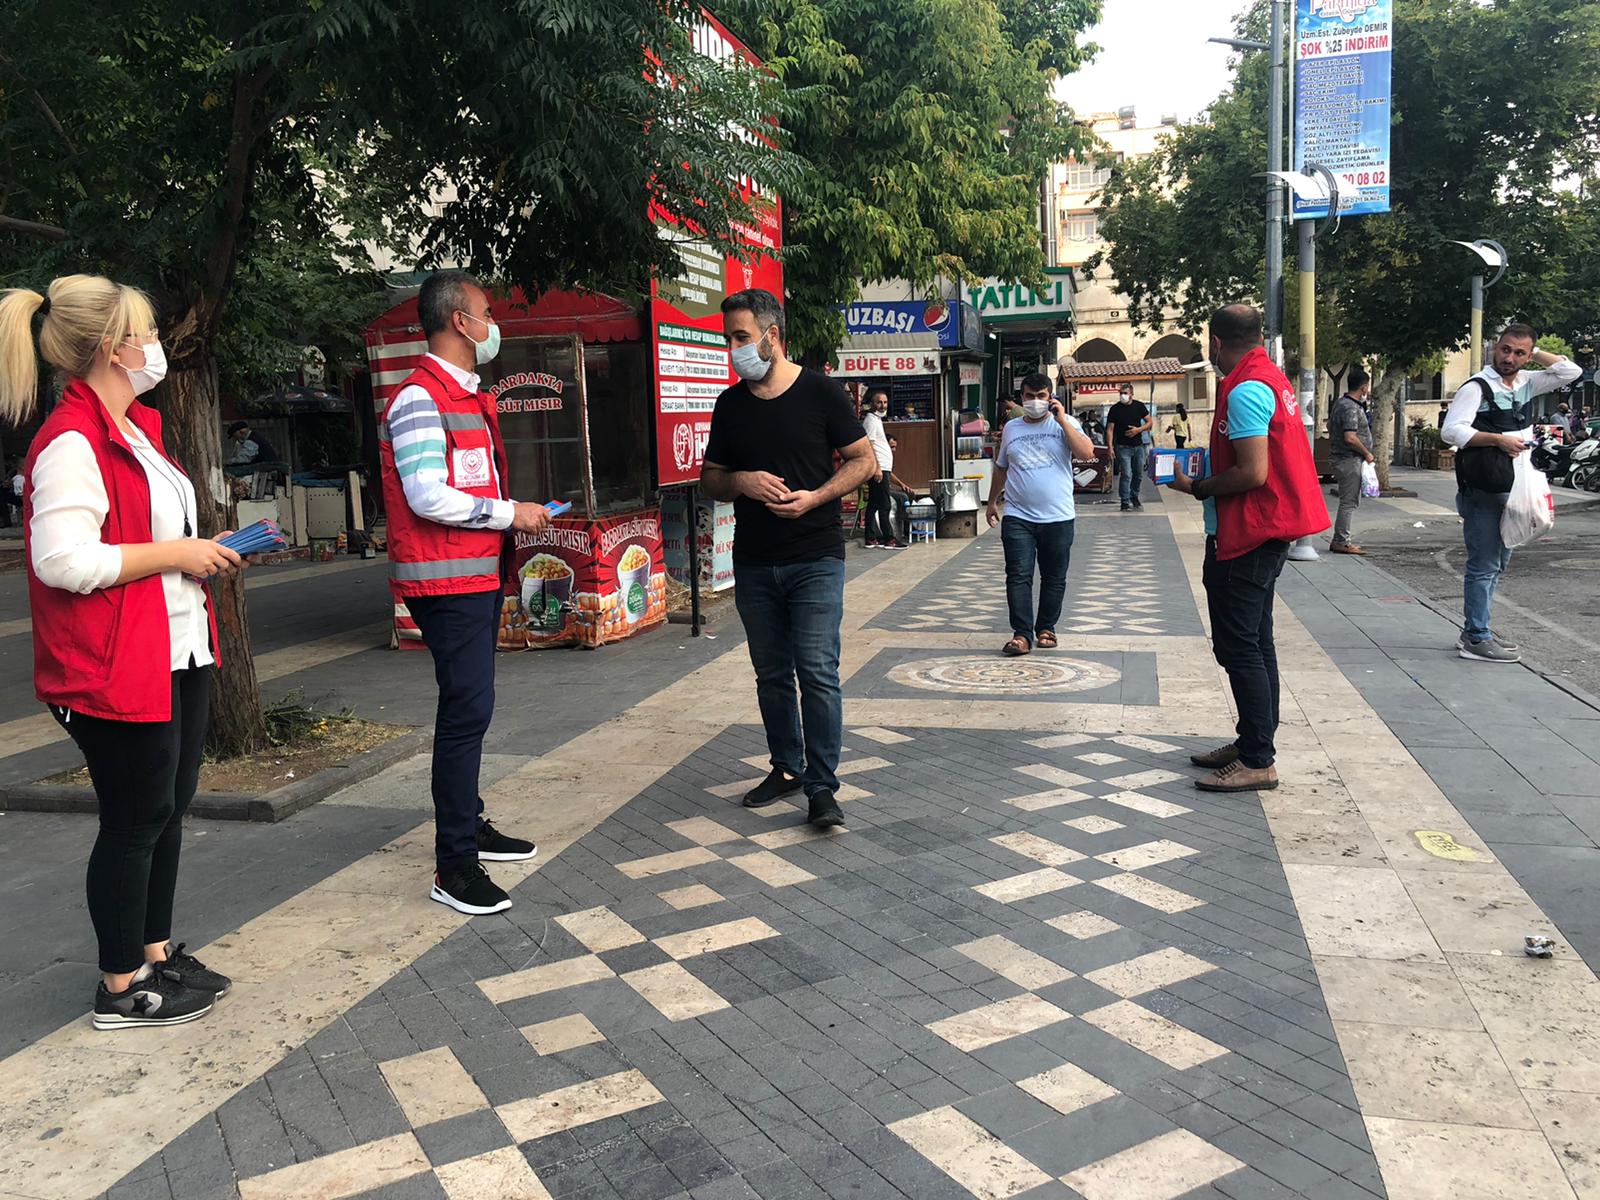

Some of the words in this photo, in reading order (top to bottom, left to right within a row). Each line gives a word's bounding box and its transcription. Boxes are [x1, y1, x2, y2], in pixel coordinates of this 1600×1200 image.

[1333, 25, 1362, 36] Zübeyde
[1300, 42, 1322, 58] ŞOK
[1325, 40, 1342, 54] %25
[1357, 172, 1369, 185] 08
[1372, 171, 1385, 184] 02
[841, 307, 915, 333] UZBAŞI
[844, 355, 889, 372] BÜFE
[895, 356, 916, 371] 88
[489, 372, 563, 399] BARDAKTA
[1081, 383, 1121, 392] TUVALE
[496, 397, 522, 413] SÜT
[523, 397, 563, 412] MISIR
[543, 525, 561, 546] SÜT
[561, 528, 592, 556] MISIR
